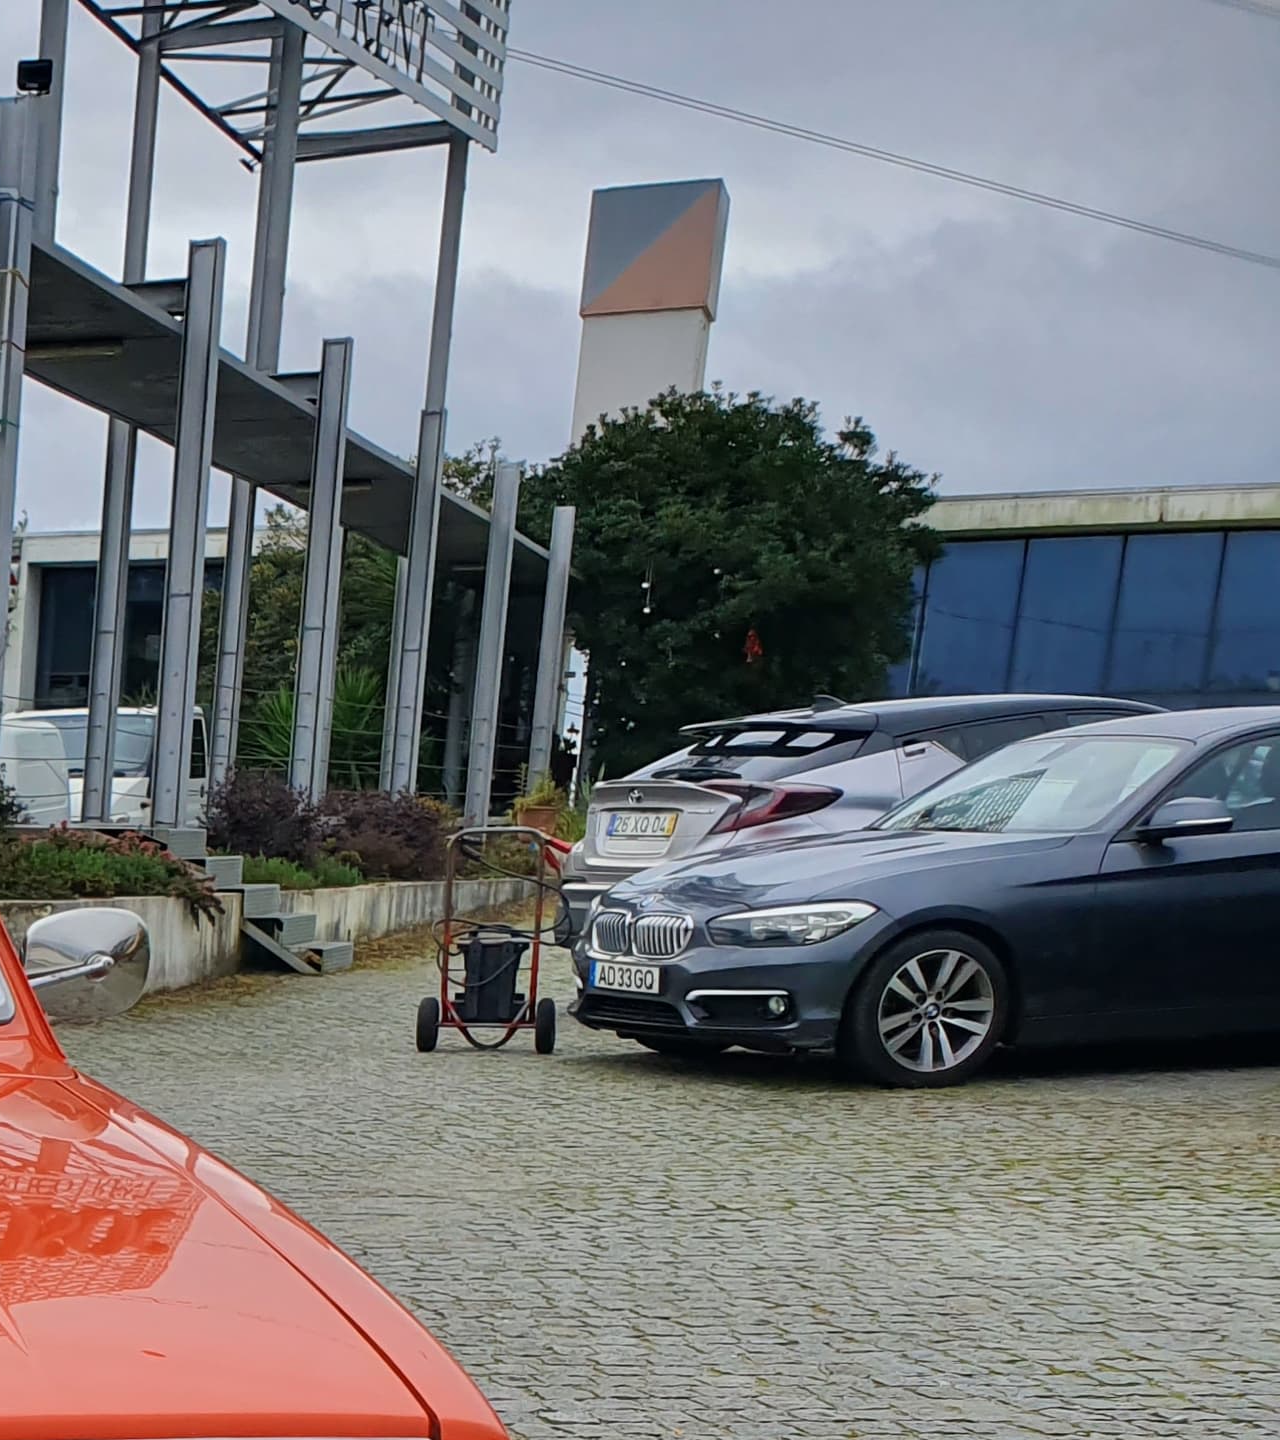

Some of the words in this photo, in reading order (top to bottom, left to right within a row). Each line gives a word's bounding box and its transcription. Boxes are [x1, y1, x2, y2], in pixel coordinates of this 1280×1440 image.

[599, 965, 615, 986] AD
[618, 967, 631, 988] 33
[634, 969, 653, 990] GQ
